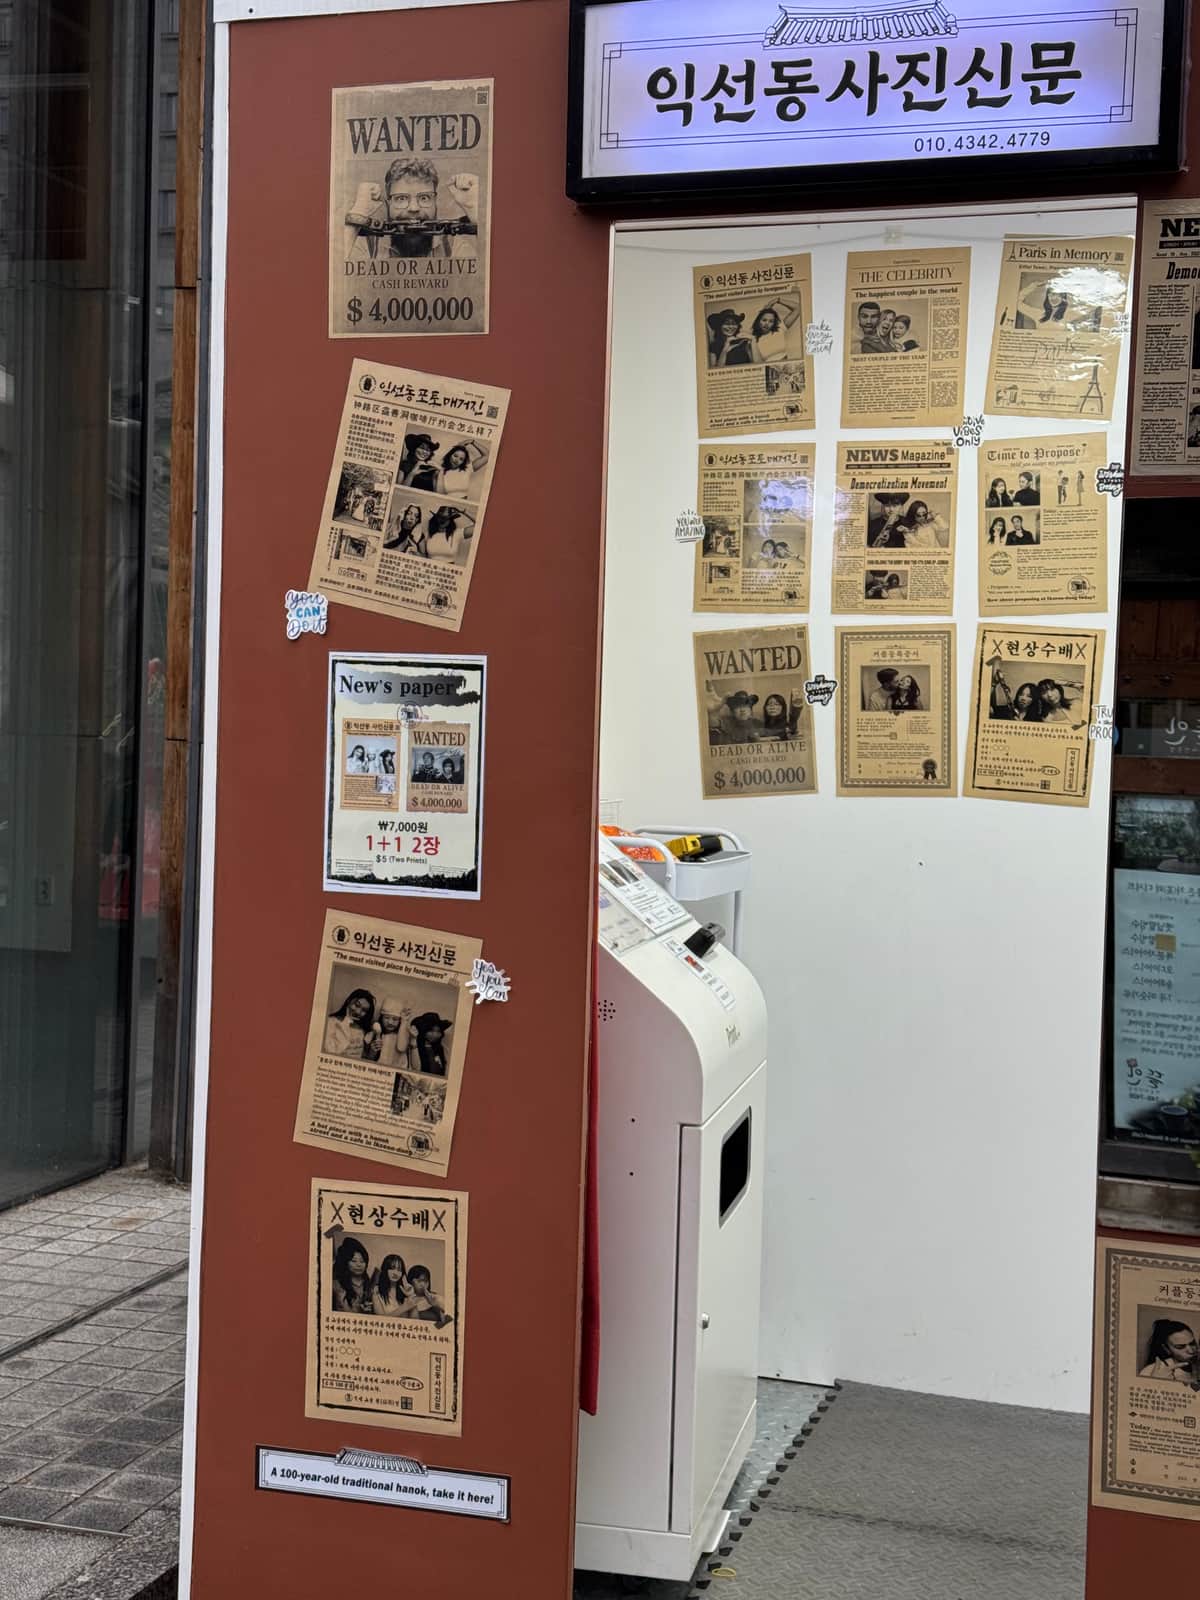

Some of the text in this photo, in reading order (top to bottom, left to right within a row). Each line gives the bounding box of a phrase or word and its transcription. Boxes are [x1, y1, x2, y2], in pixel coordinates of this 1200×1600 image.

[646, 41, 1082, 126] 익선동사진신문
[346, 114, 482, 154] WANTED
[914, 131, 1051, 153] 010.4342.4779
[1019, 247, 1112, 263] Paris in Memory
[344, 259, 477, 276] DEAD OR ALIVE
[716, 267, 794, 287] 익선동 사진신문
[859, 267, 953, 283] THE CELEBRITY
[372, 278, 449, 289] CASH REWARD
[868, 290, 896, 298] happiest
[940, 286, 958, 294] world
[369, 296, 474, 325] 4,000,000
[379, 381, 484, 416] 익선동 포토 매거진
[719, 453, 798, 466] 익선동 포토 매거진
[846, 448, 946, 462] NEWS Magazine
[987, 450, 1017, 461] Time
[1019, 450, 1030, 459] to
[850, 476, 948, 489] Democratization Movement
[296, 606, 320, 618] CAN
[1006, 639, 1073, 660] 현상수배
[704, 645, 802, 676] WANTED
[339, 675, 457, 698] New's paper
[413, 731, 466, 746] WANTED
[710, 741, 807, 758] DEAD OR ALIVE
[730, 767, 806, 788] 4,000,000
[366, 835, 440, 856] 1+1 2장
[354, 932, 457, 966] 익선동 사진신문
[349, 954, 364, 963] most
[365, 957, 385, 968] visited
[386, 962, 403, 972] place
[404, 964, 412, 974] by
[346, 1204, 430, 1231] 현상수배
[1159, 1284, 1200, 1299] 커플등
[270, 1467, 494, 1505] A 100-year-old traditional hanok, take it here!
